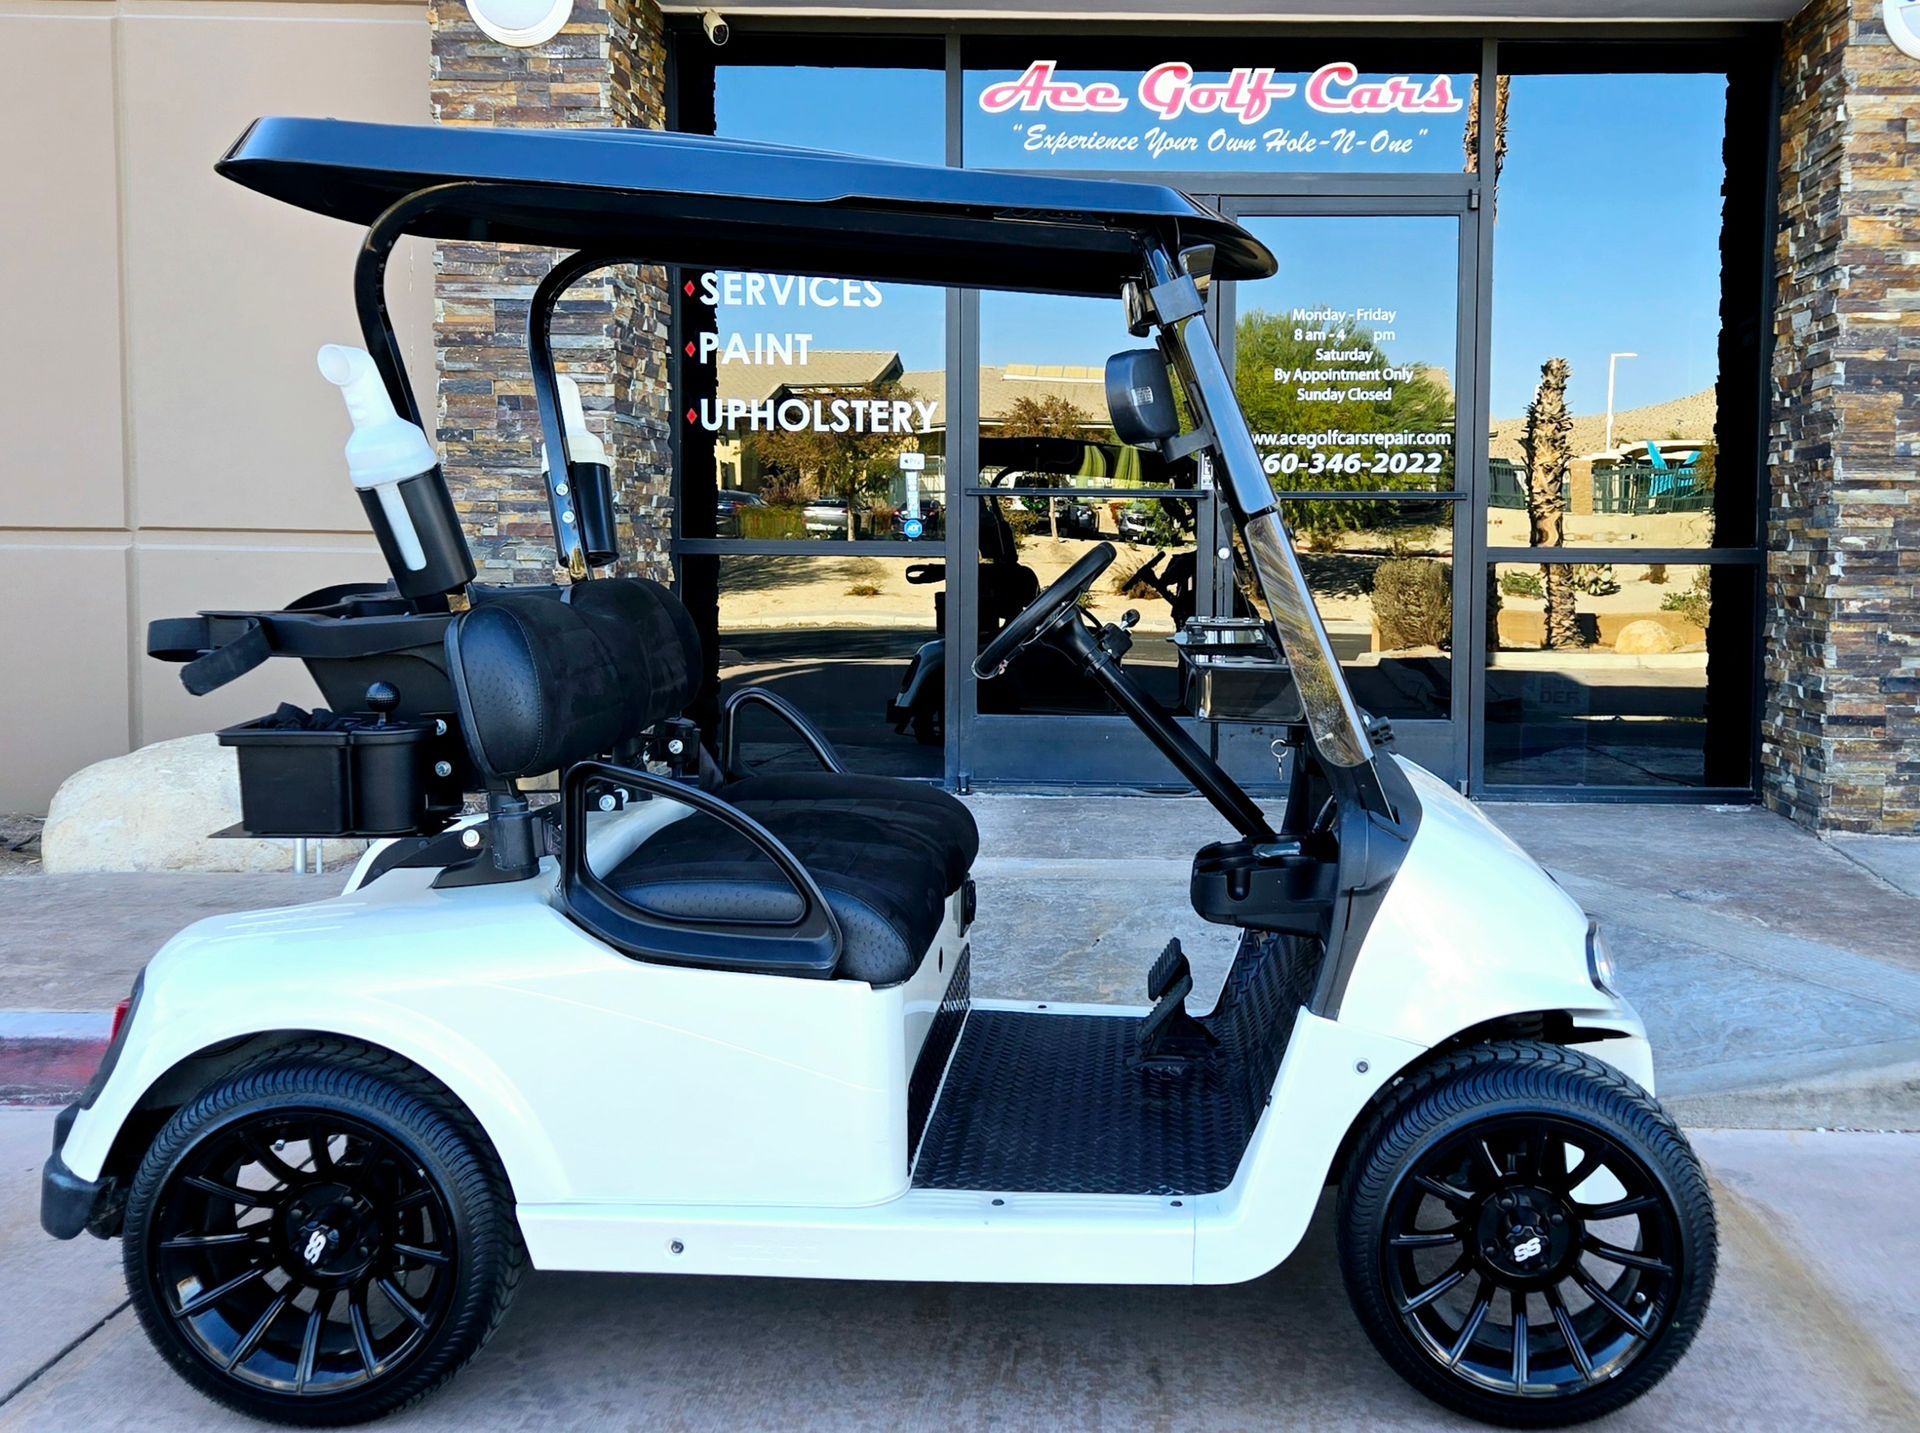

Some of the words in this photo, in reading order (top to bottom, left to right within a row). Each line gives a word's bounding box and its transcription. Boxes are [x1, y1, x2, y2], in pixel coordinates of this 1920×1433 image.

[979, 60, 1129, 113] Ace
[1138, 62, 1297, 125] Golf
[1305, 62, 1463, 113] Cars
[1144, 127, 1199, 159] Your
[1207, 128, 1257, 152] Own
[700, 272, 883, 308] SERVICES
[1293, 308, 1346, 323] Monday
[1357, 308, 1397, 323] Friday
[1294, 329, 1303, 341] 8
[1305, 331, 1326, 341] am
[1336, 329, 1346, 341] 4
[1373, 330, 1396, 344] pm
[699, 332, 813, 366] PAINT
[1315, 348, 1374, 364] Saturday
[1274, 369, 1291, 384] By
[1293, 368, 1380, 384] Appointment
[1382, 368, 1414, 384] Only
[1297, 387, 1346, 404] Sunday
[1347, 387, 1392, 401] Closed
[700, 398, 939, 433] UPHOLSTERY
[1251, 429, 1451, 449] ww.acegolfcarsrepair.com
